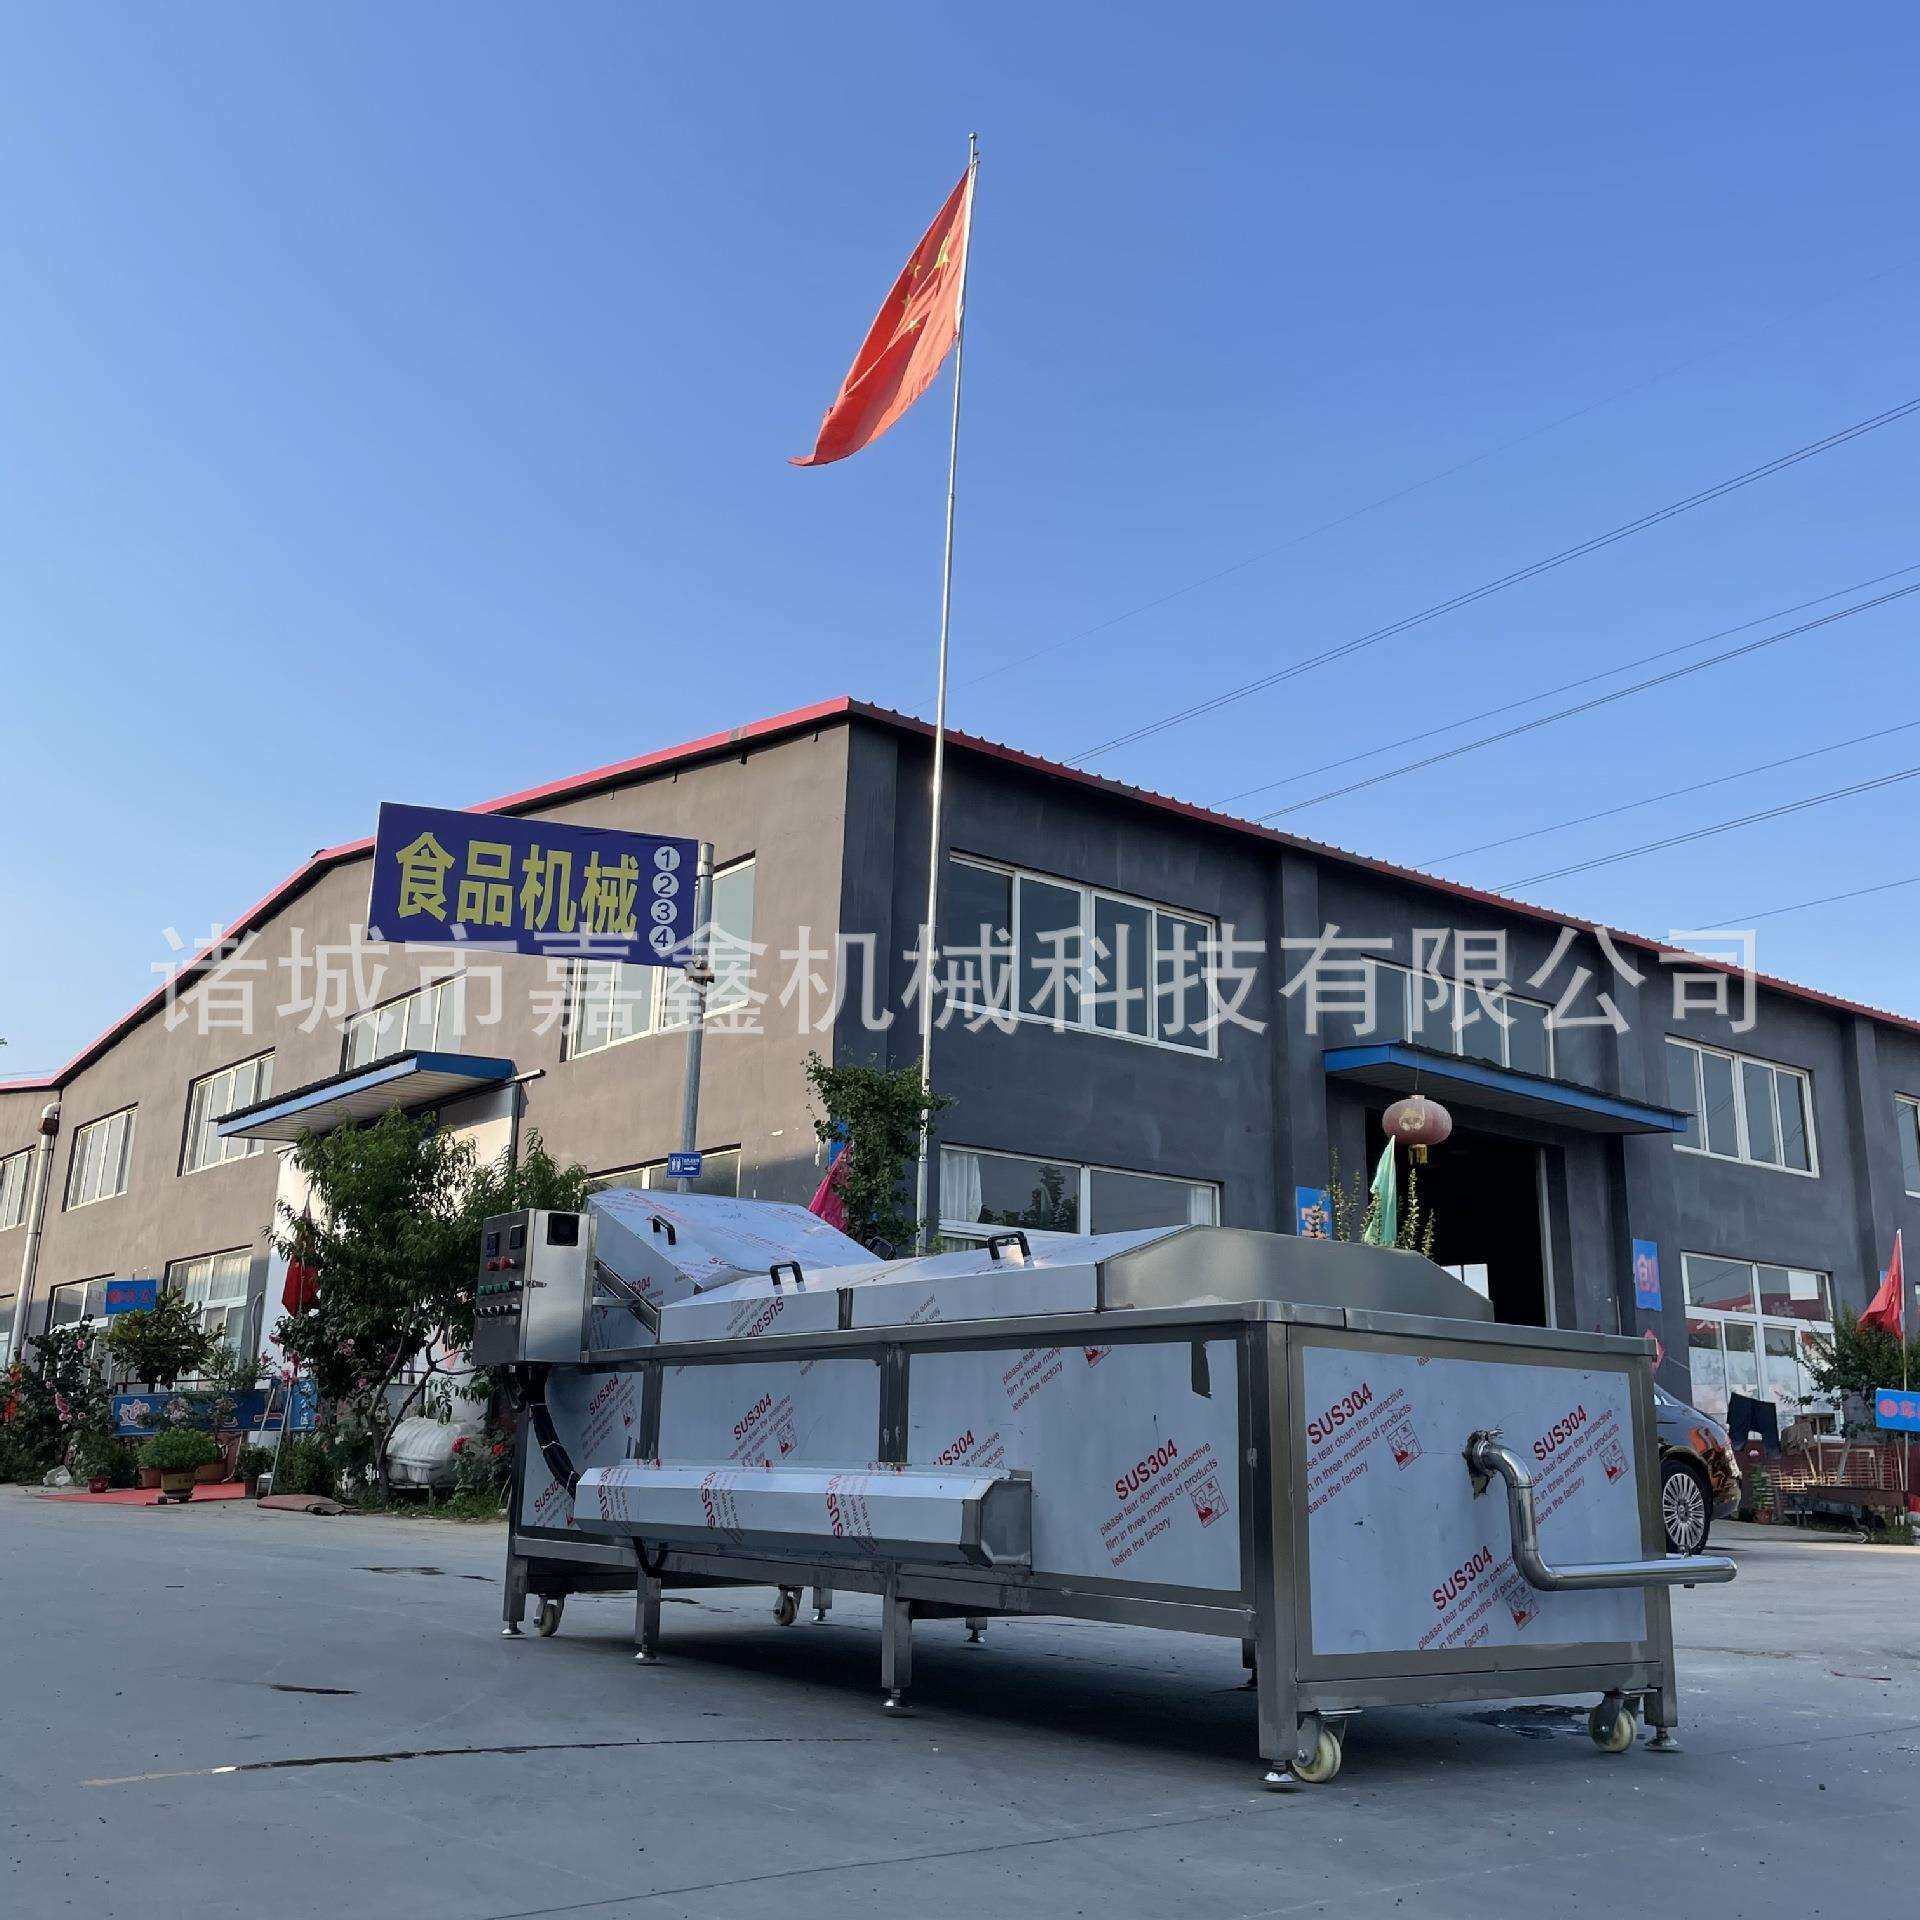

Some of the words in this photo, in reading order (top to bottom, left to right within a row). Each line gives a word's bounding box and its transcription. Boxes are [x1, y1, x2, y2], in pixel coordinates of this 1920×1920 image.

[396, 831, 640, 939] 食品机械
[589, 1372, 619, 1416] SUS304
[1040, 1360, 1063, 1385] factory
[733, 1392, 773, 1441] SUS304
[1307, 1382, 1373, 1445] SUS304
[1318, 1444, 1336, 1460] tear
[1335, 1427, 1357, 1447] down
[1356, 1415, 1369, 1431] the
[1369, 1388, 1405, 1420] protective
[1322, 1459, 1343, 1480] three
[1343, 1436, 1372, 1464] months
[1372, 1427, 1382, 1440] of
[1380, 1403, 1412, 1436] products
[1533, 1405, 1588, 1461] SUS304
[534, 1480, 560, 1513] SUS30
[1100, 1511, 1124, 1536] please
[1123, 1500, 1140, 1516] tear
[1139, 1482, 1160, 1503] down
[1159, 1472, 1173, 1487] the
[1173, 1442, 1211, 1477] protective
[1115, 1439, 1178, 1500] SUS304
[1327, 1483, 1342, 1499] the
[1341, 1460, 1369, 1486] factory
[1105, 1535, 1119, 1551] film
[1119, 1531, 1128, 1540] in
[1127, 1514, 1146, 1535] three
[1146, 1492, 1175, 1520] months
[1175, 1484, 1185, 1496] of
[1184, 1458, 1218, 1492] products
[1111, 1547, 1133, 1568] leave
[1132, 1537, 1146, 1552] the
[1145, 1517, 1171, 1542] factory
[1433, 1545, 1493, 1611] SUS304
[1418, 1624, 1443, 1650] please
[1442, 1609, 1458, 1627] tear
[1458, 1590, 1478, 1612] down
[1477, 1580, 1489, 1593] the
[1446, 1624, 1466, 1645] three
[1466, 1598, 1493, 1626] months
[1492, 1588, 1500, 1602] of
[1464, 1622, 1489, 1649] factory
